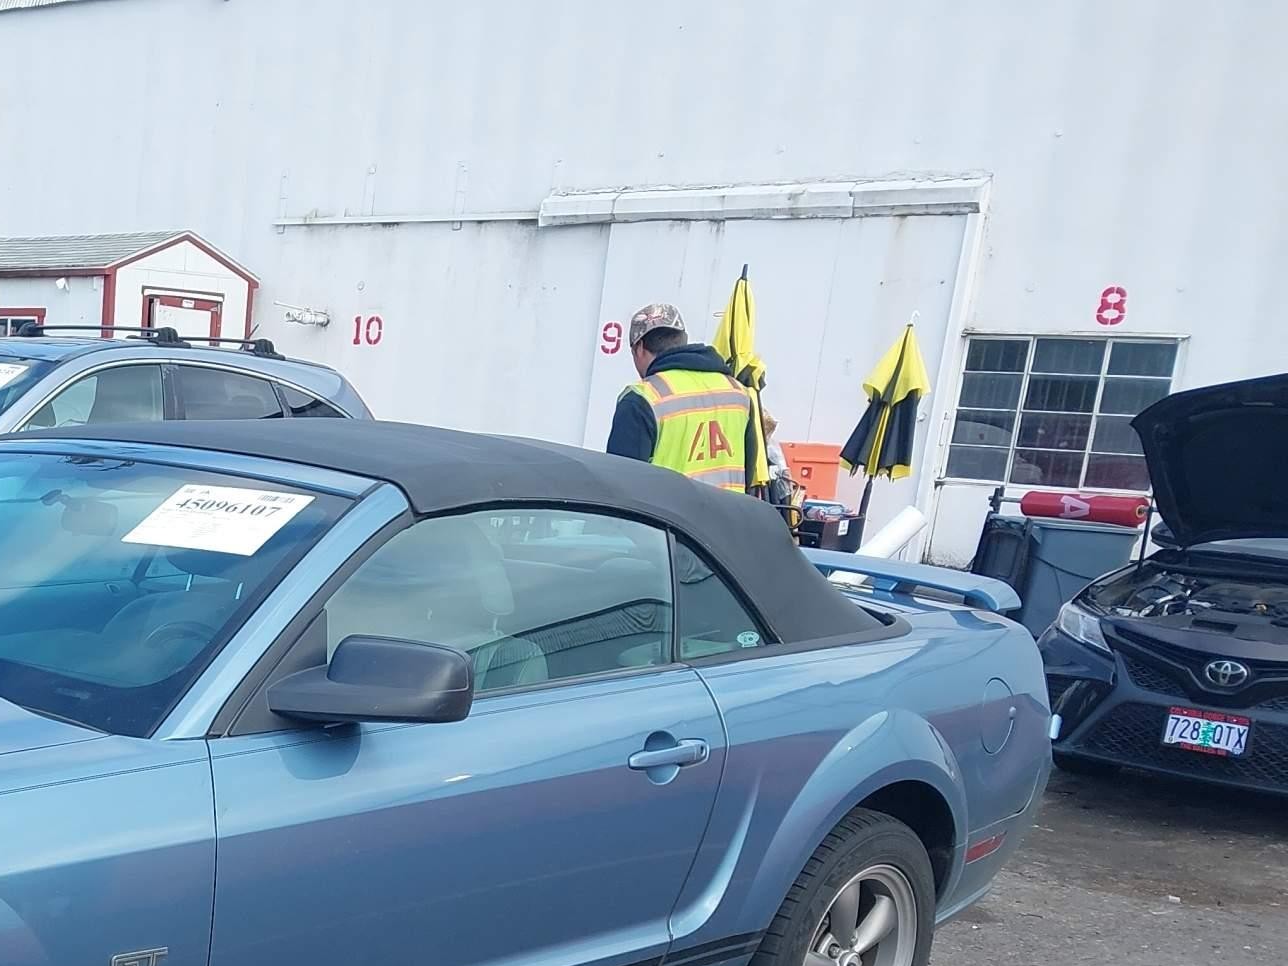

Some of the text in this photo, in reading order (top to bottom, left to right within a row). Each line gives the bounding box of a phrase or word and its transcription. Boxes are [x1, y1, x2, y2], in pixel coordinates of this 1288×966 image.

[1096, 286, 1127, 325] 8
[353, 315, 383, 345] 10
[601, 322, 622, 354] 9
[175, 497, 283, 518] 45096107
[1170, 716, 1201, 740] 728
[1212, 724, 1247, 749] QTX
